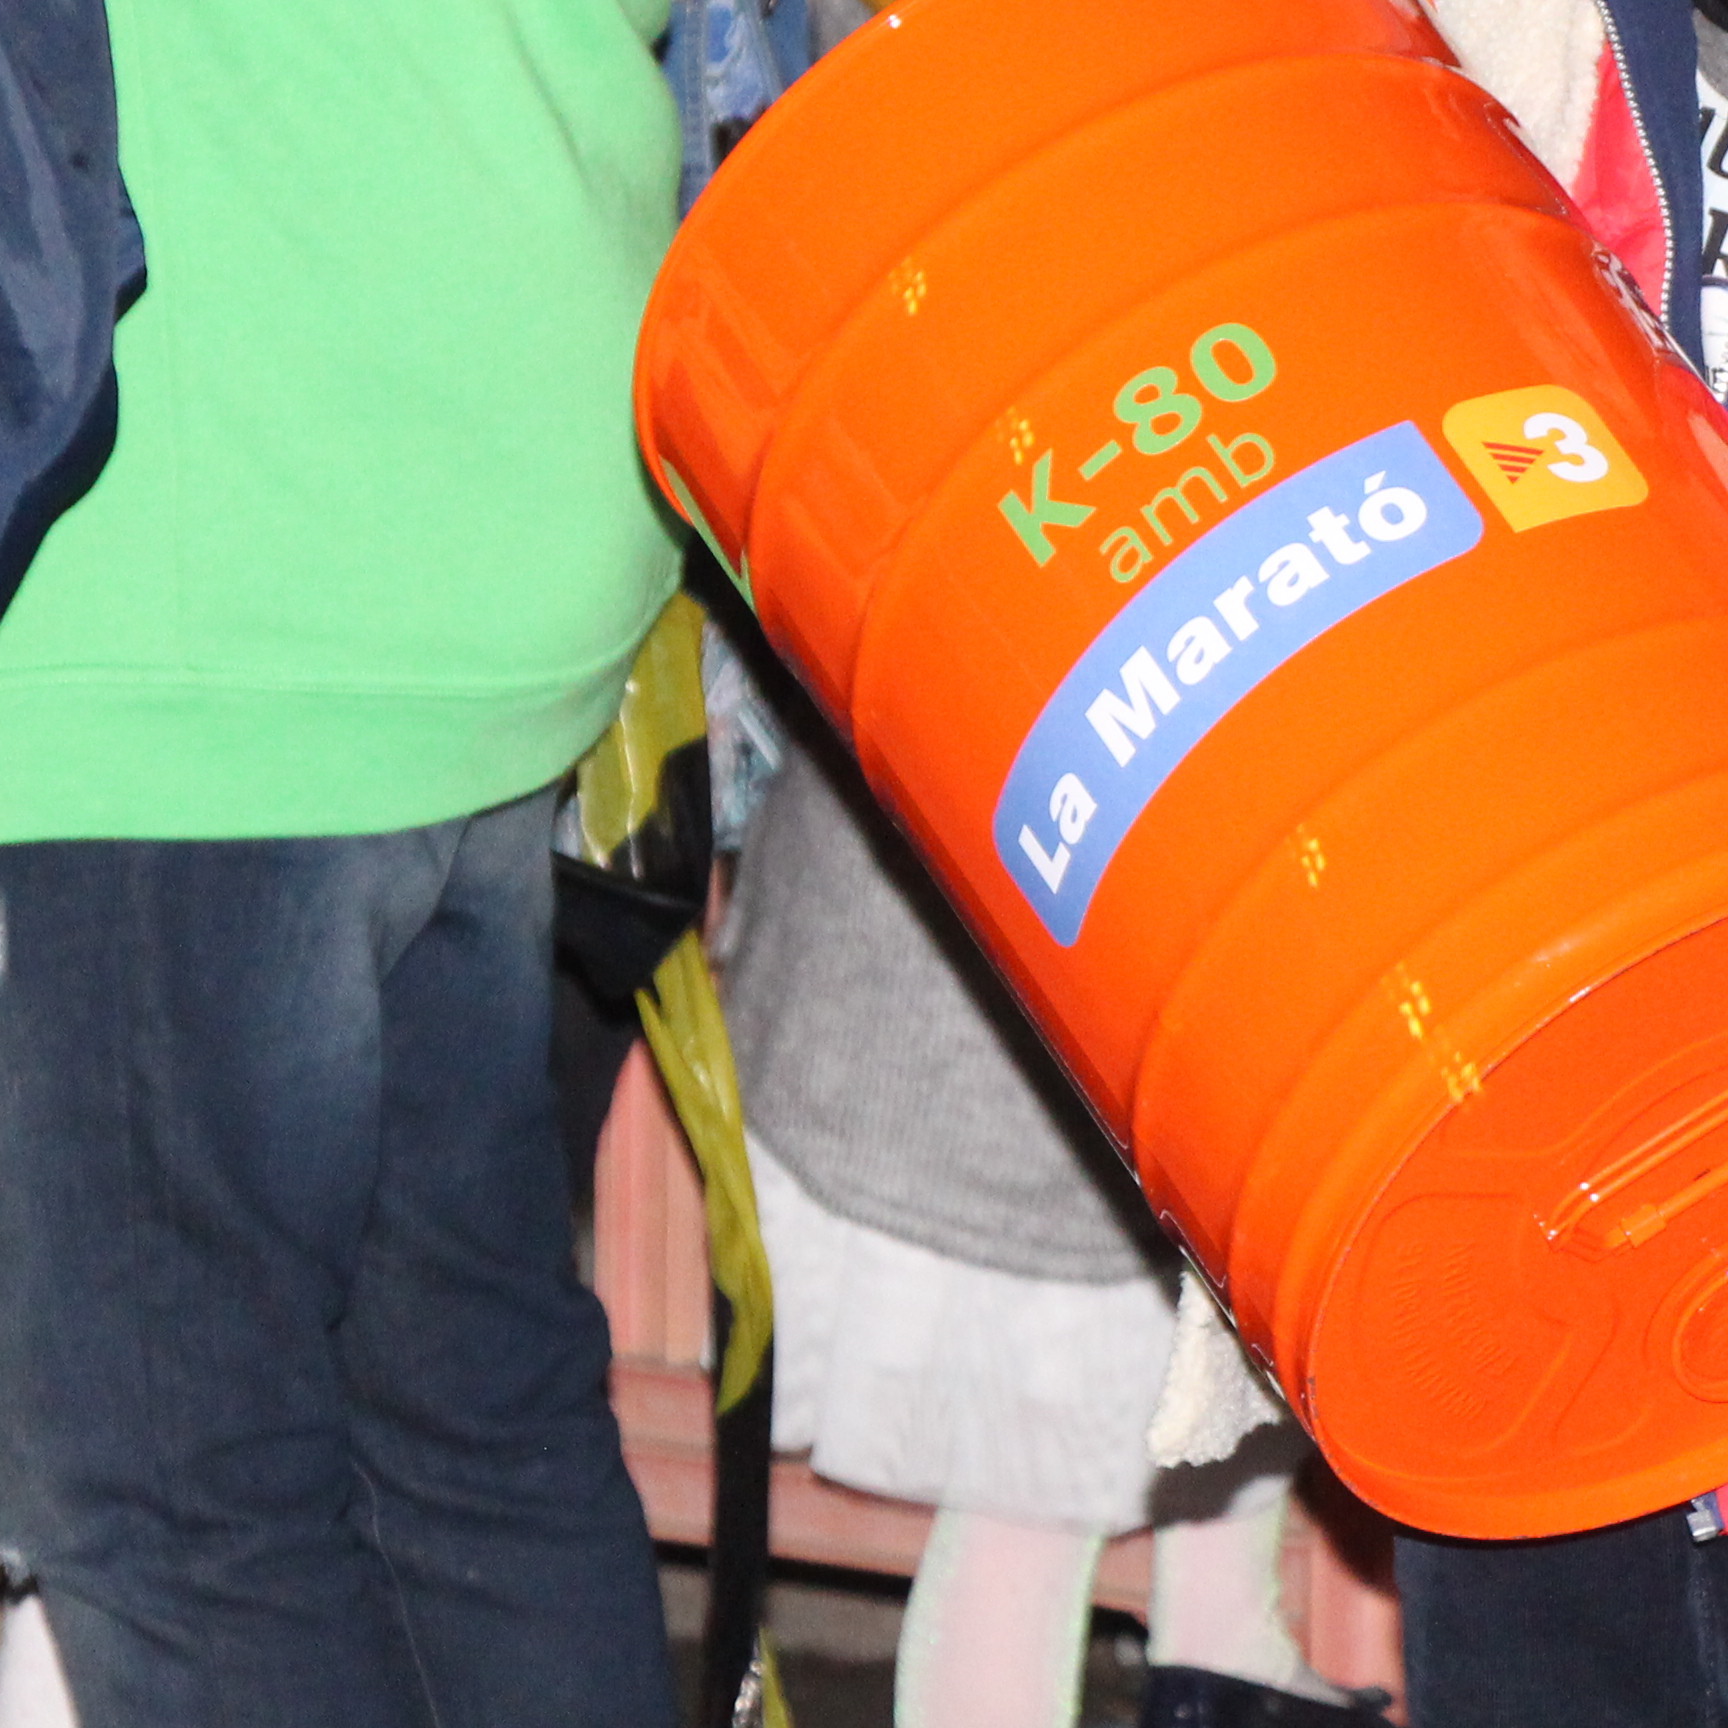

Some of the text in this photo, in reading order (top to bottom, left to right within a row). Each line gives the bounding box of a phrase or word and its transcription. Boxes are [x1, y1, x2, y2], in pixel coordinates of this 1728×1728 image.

[998, 322, 1277, 567] K-80
[1098, 430, 1277, 584] amb
[1522, 411, 1610, 483] 3
[1017, 470, 1429, 895] La Marató
